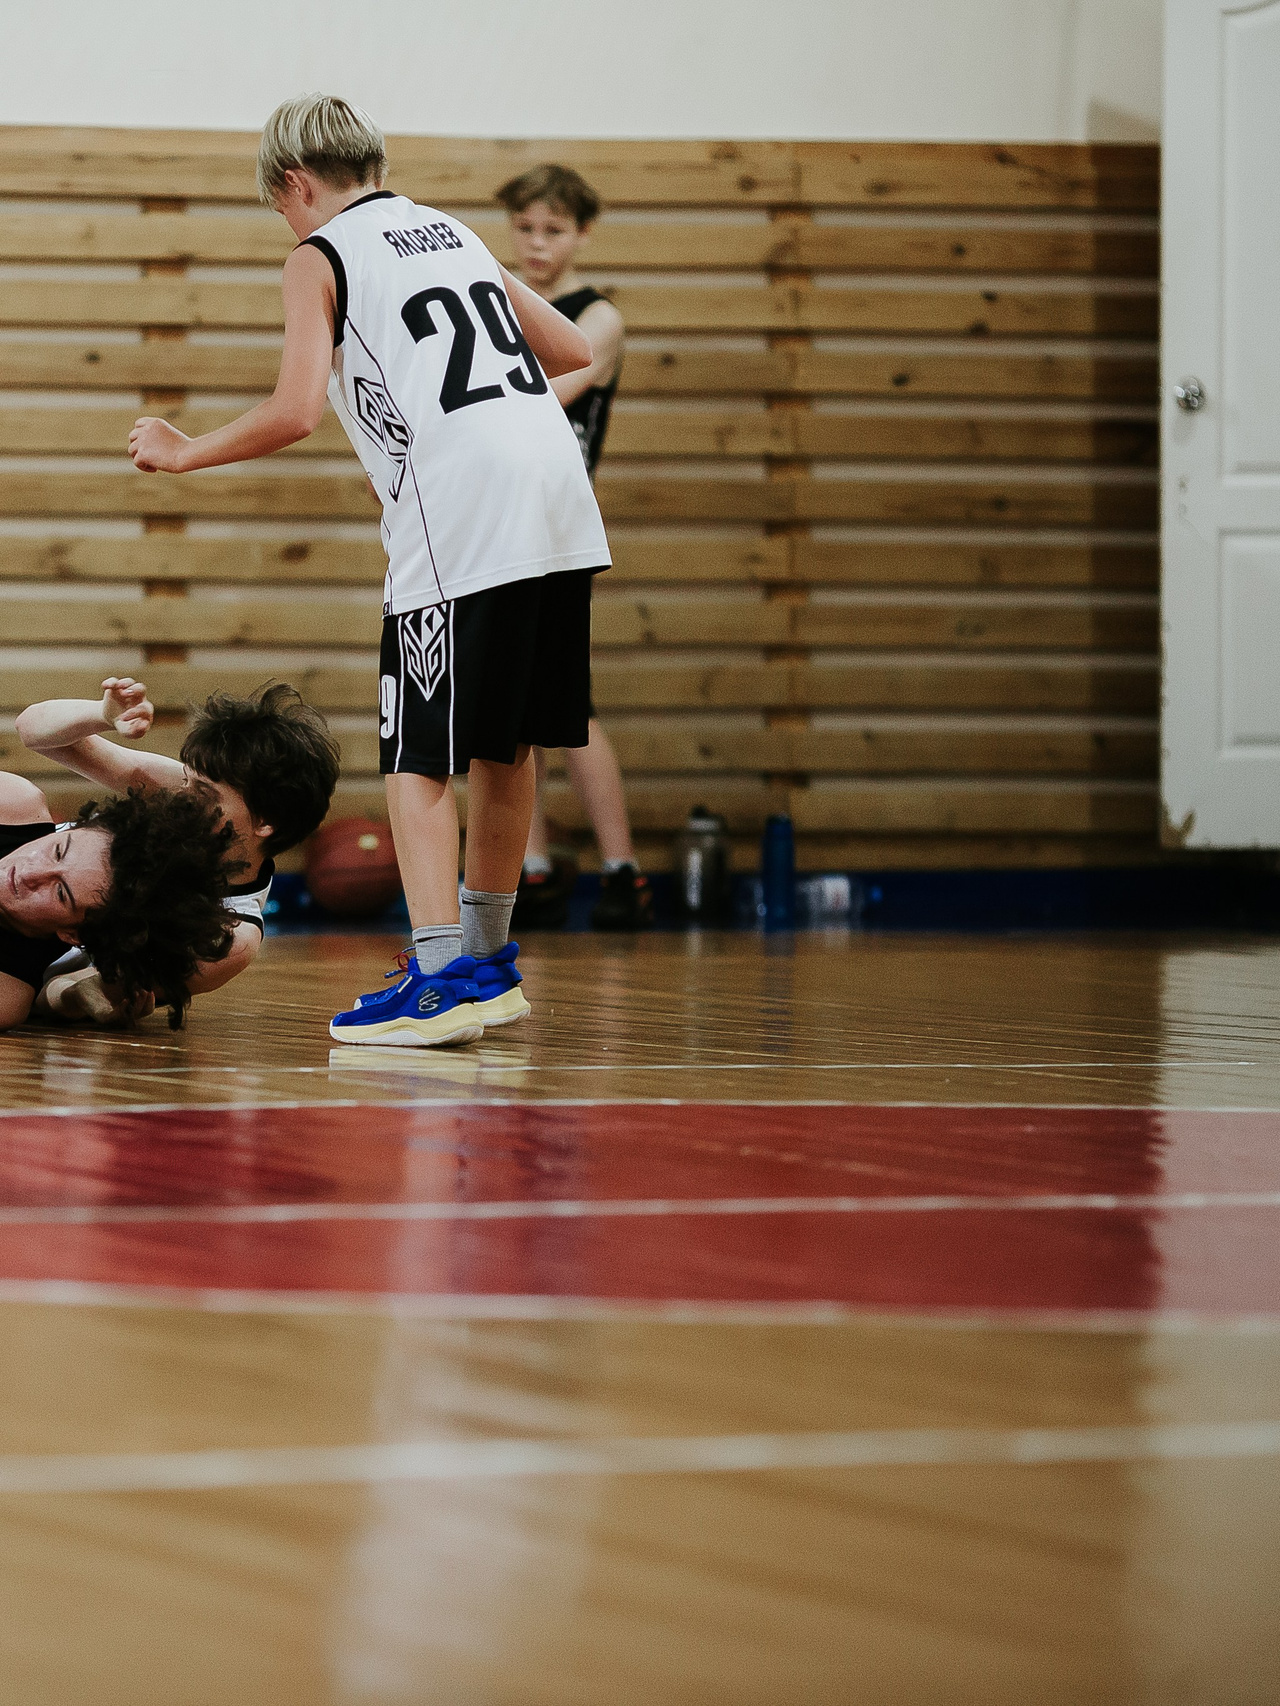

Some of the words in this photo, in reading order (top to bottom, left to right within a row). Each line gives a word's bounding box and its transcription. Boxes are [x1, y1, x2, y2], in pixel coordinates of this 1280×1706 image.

[382, 222, 464, 258] ЯКОВЛЕВ
[400, 280, 549, 415] 29
[378, 674, 397, 739] 9
